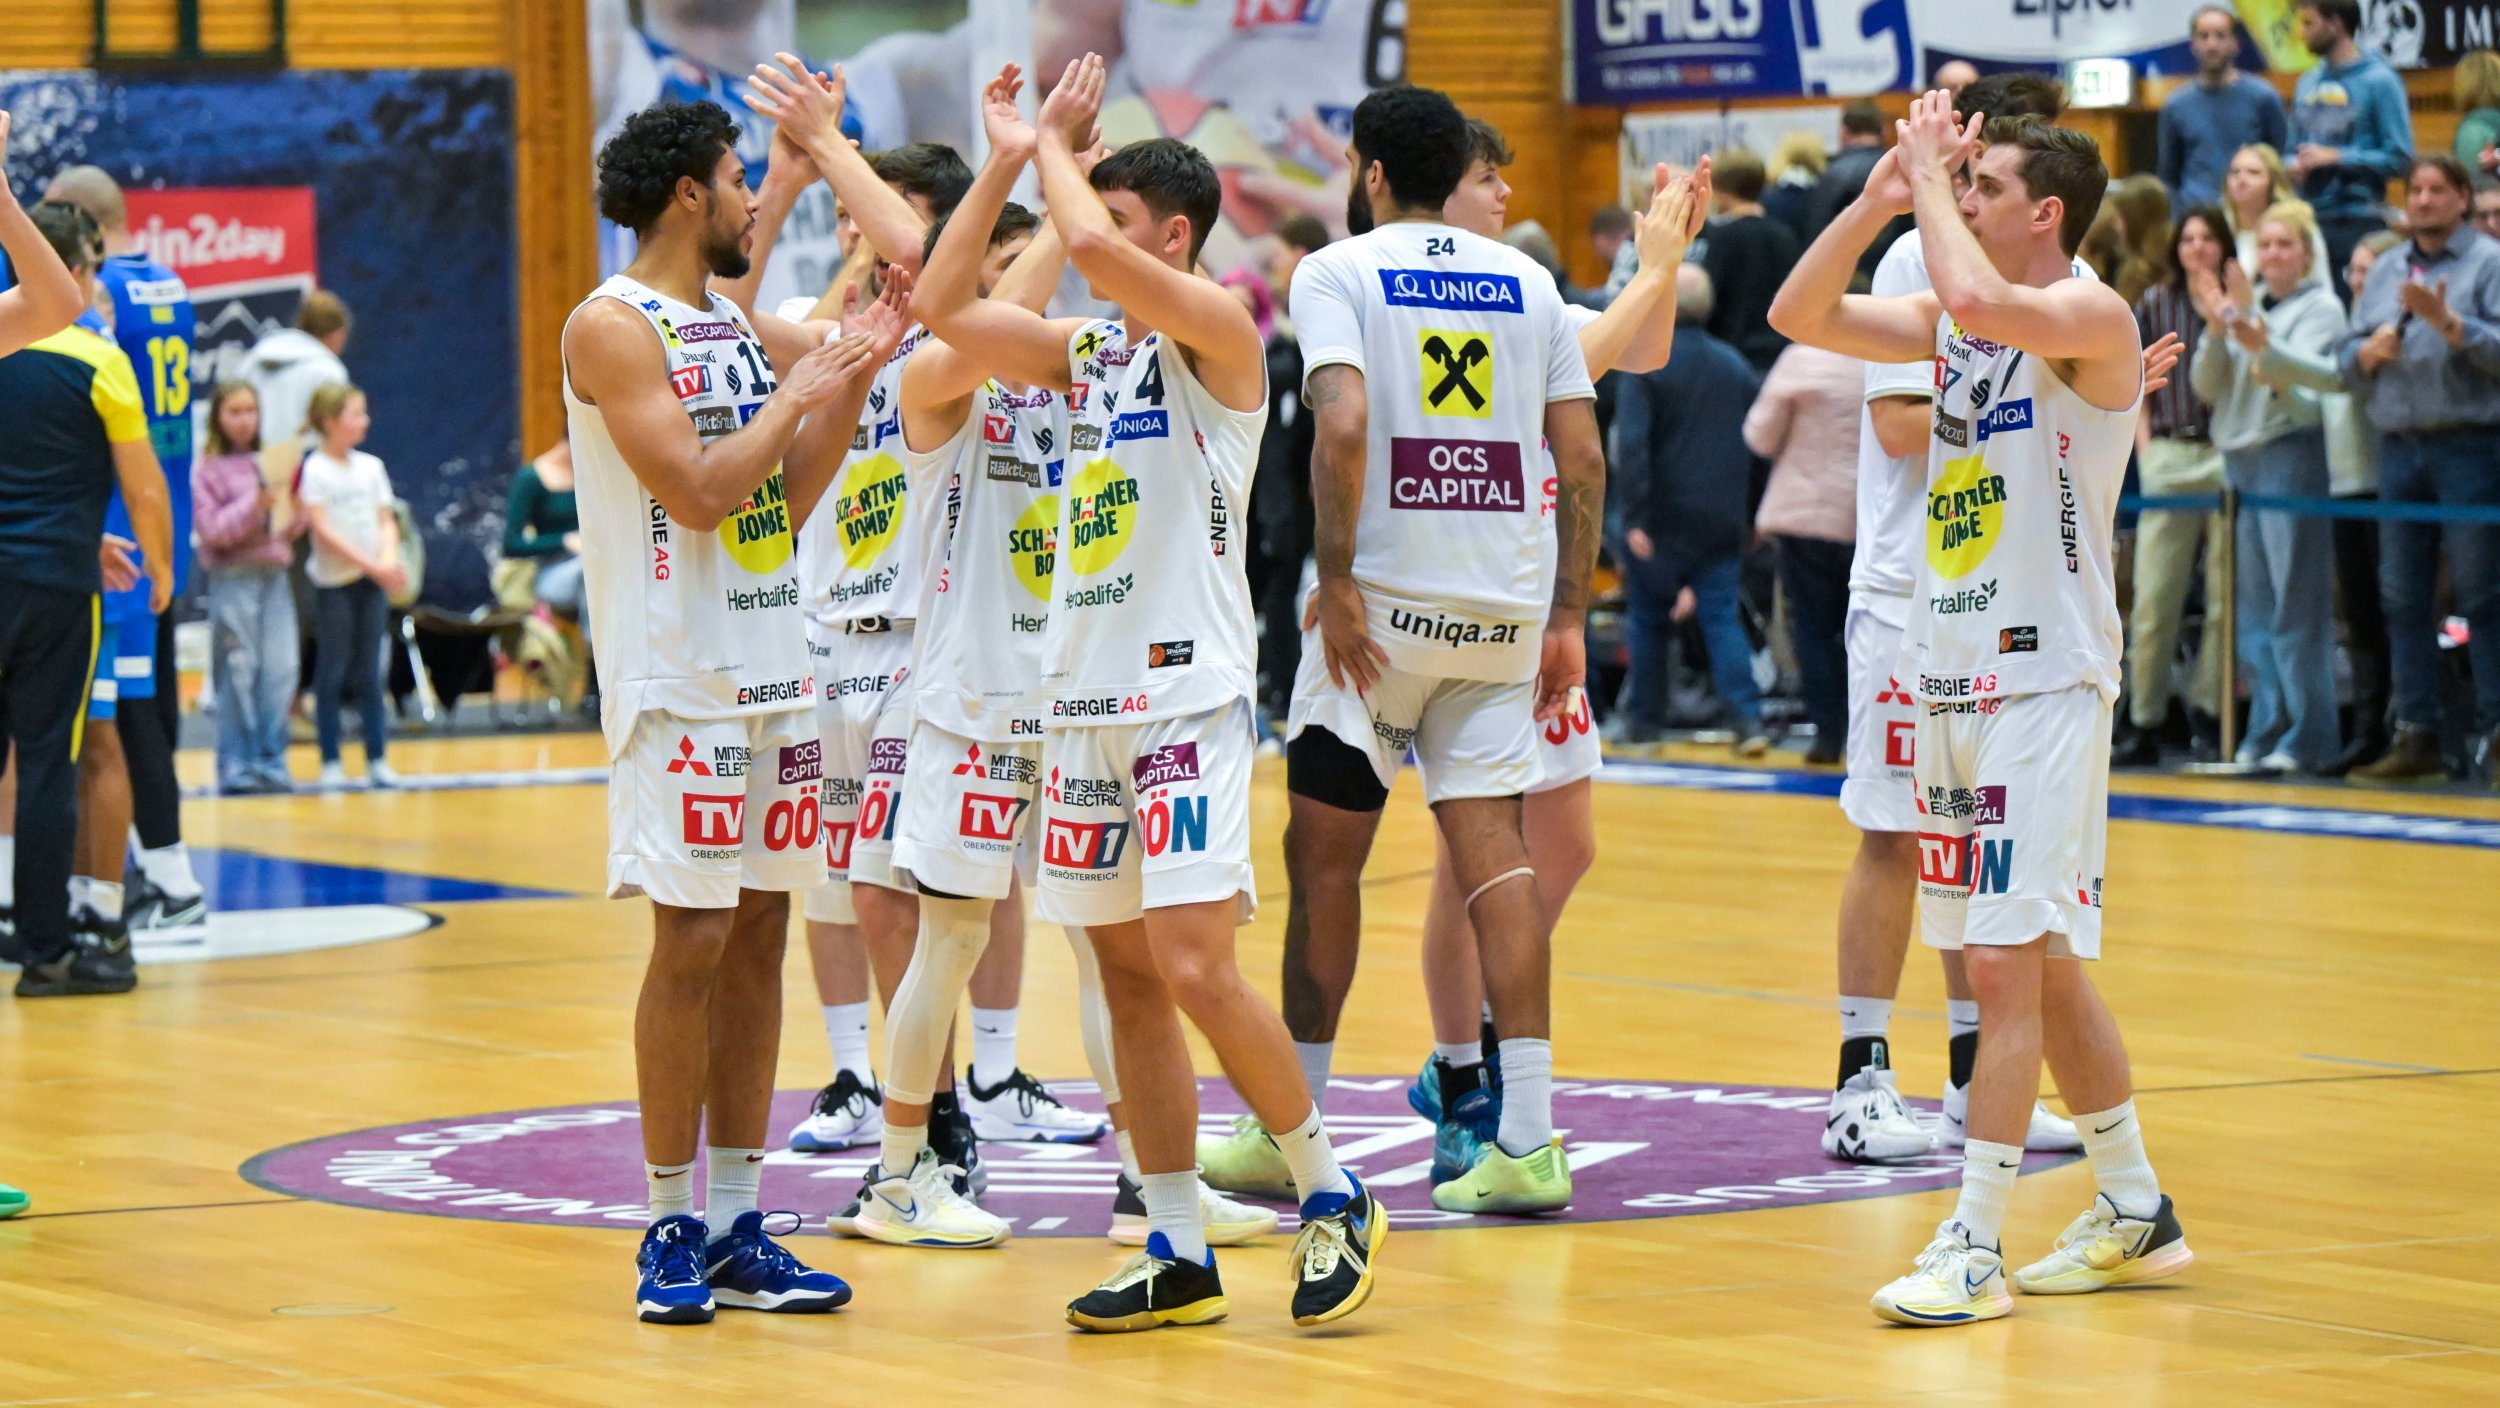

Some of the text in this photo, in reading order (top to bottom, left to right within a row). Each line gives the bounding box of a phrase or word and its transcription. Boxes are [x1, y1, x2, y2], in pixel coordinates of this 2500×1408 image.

[1426, 237, 1456, 256] 24
[1430, 278, 1515, 304] UNIQA
[680, 325, 705, 341] OCS
[147, 335, 190, 416] 13
[673, 367, 710, 395] TV1
[1135, 349, 1166, 406] 4
[1428, 445, 1489, 472] OCS
[1395, 477, 1520, 505] CAPITAL
[737, 505, 788, 544] BOMBE
[1009, 526, 1058, 553] SCHA
[654, 546, 670, 580] AG
[727, 584, 798, 611] Herbalife
[1390, 608, 1519, 648] uniqa.at
[737, 680, 800, 705] ENERGIE
[1971, 674, 1997, 694] AG
[1053, 694, 1148, 717] ENERGIE AG
[795, 744, 819, 761] OCS
[1150, 749, 1175, 764] CS
[1135, 763, 1197, 791] CAPITAL
[1890, 769, 1914, 778] OBE
[763, 785, 824, 852] OÖ
[1050, 824, 1122, 863] TV1
[1046, 868, 1119, 882] OBERÖSTERREICH
